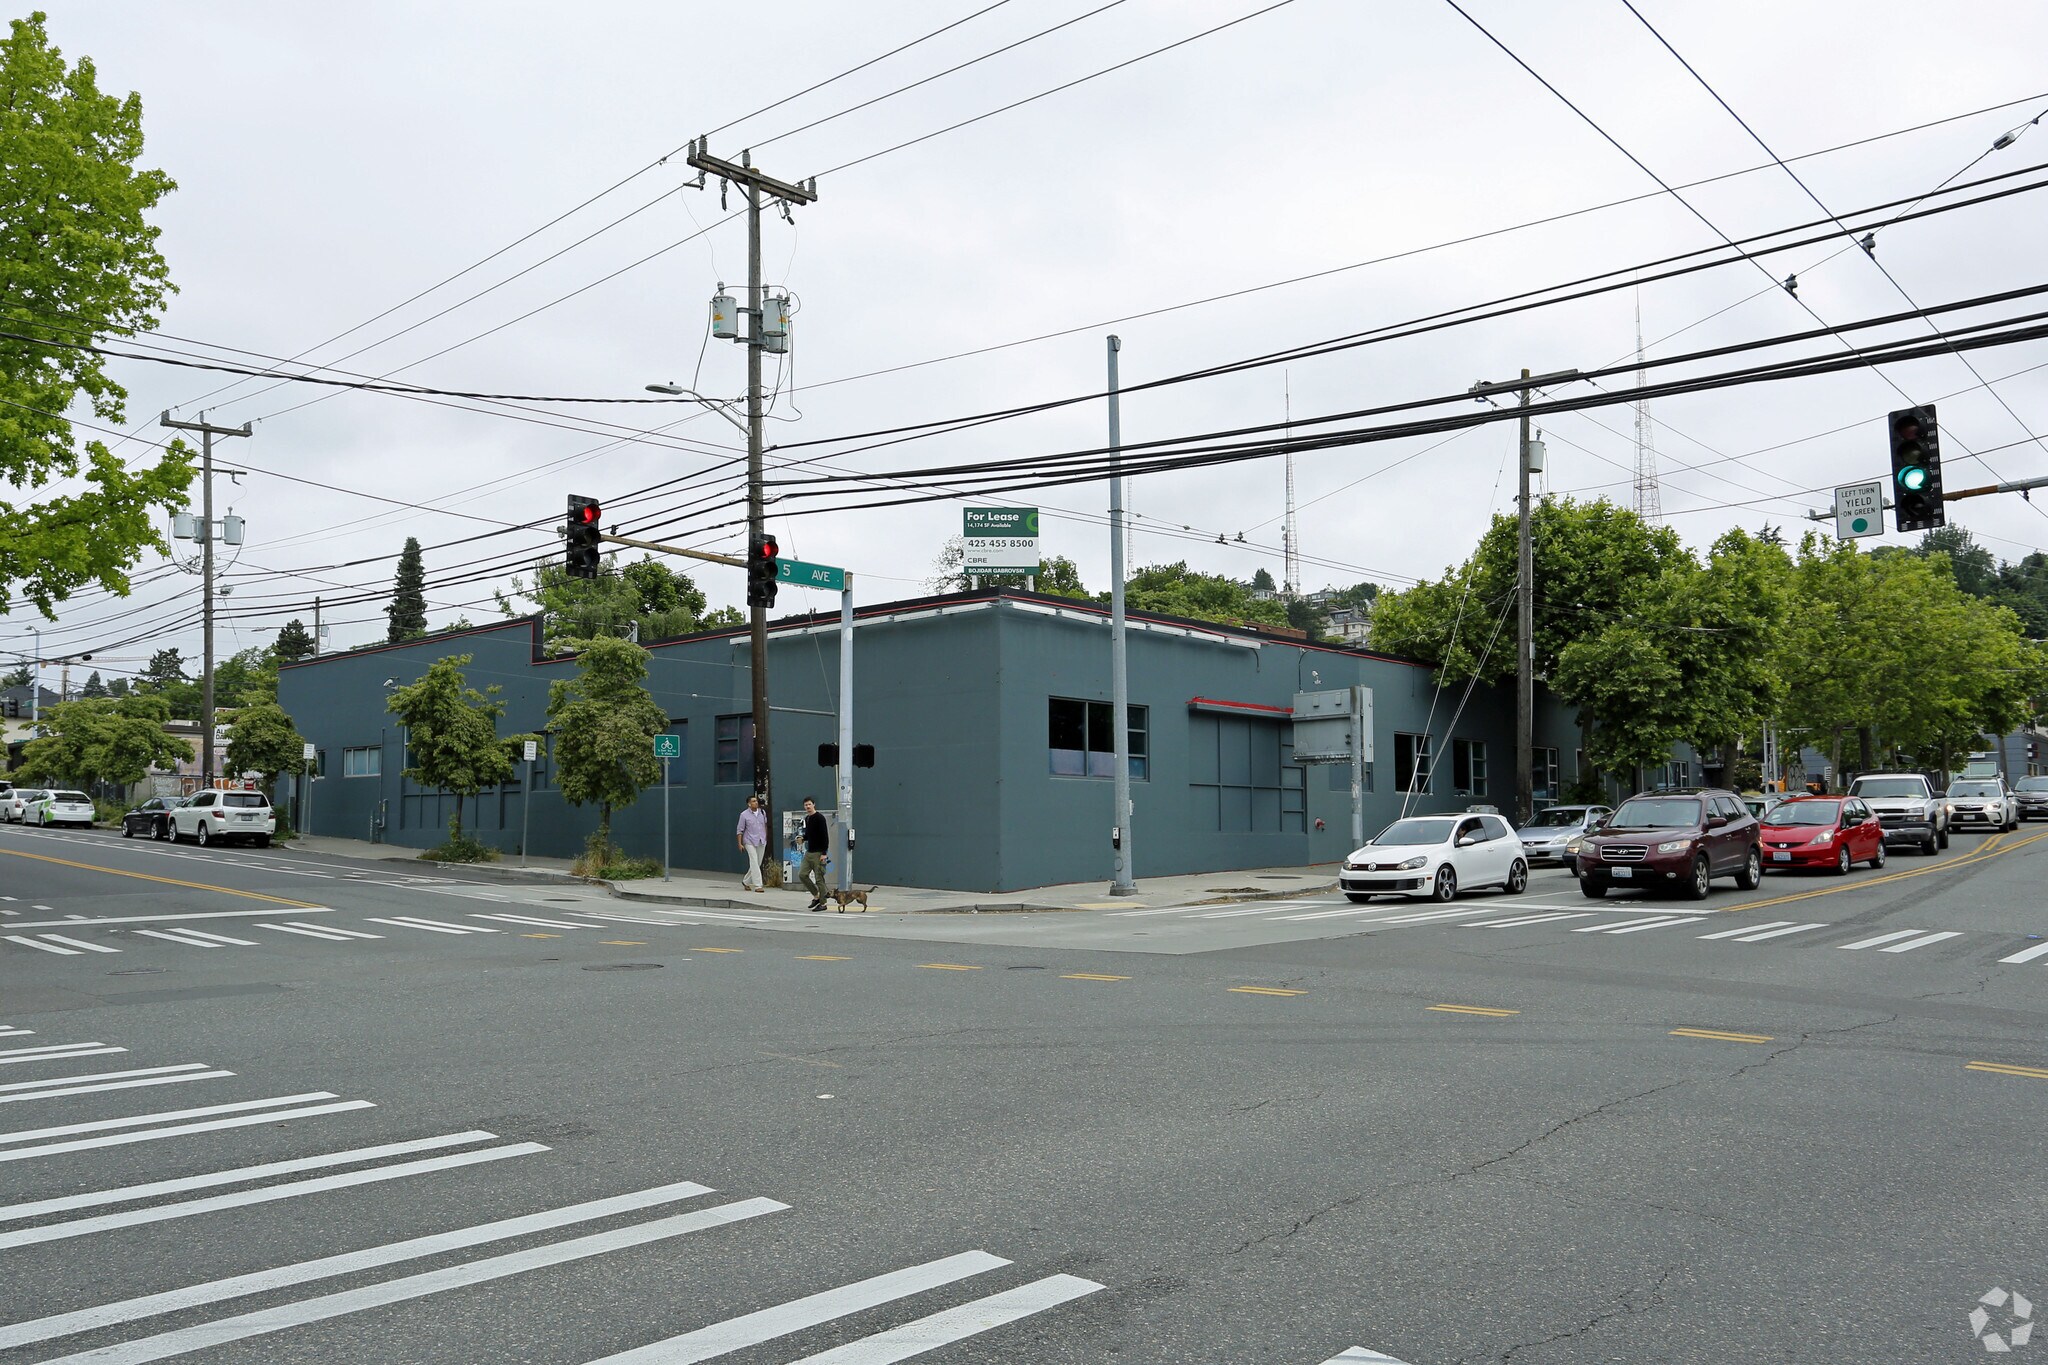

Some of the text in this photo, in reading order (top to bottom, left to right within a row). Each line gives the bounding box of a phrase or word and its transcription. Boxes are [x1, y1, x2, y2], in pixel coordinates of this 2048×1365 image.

[1842, 490, 1856, 498] LEFT
[1846, 497, 1871, 507] YIELD
[1855, 507, 1875, 515] GREEN
[967, 512, 1019, 521] For Lease
[783, 564, 830, 582] 5 AVE
